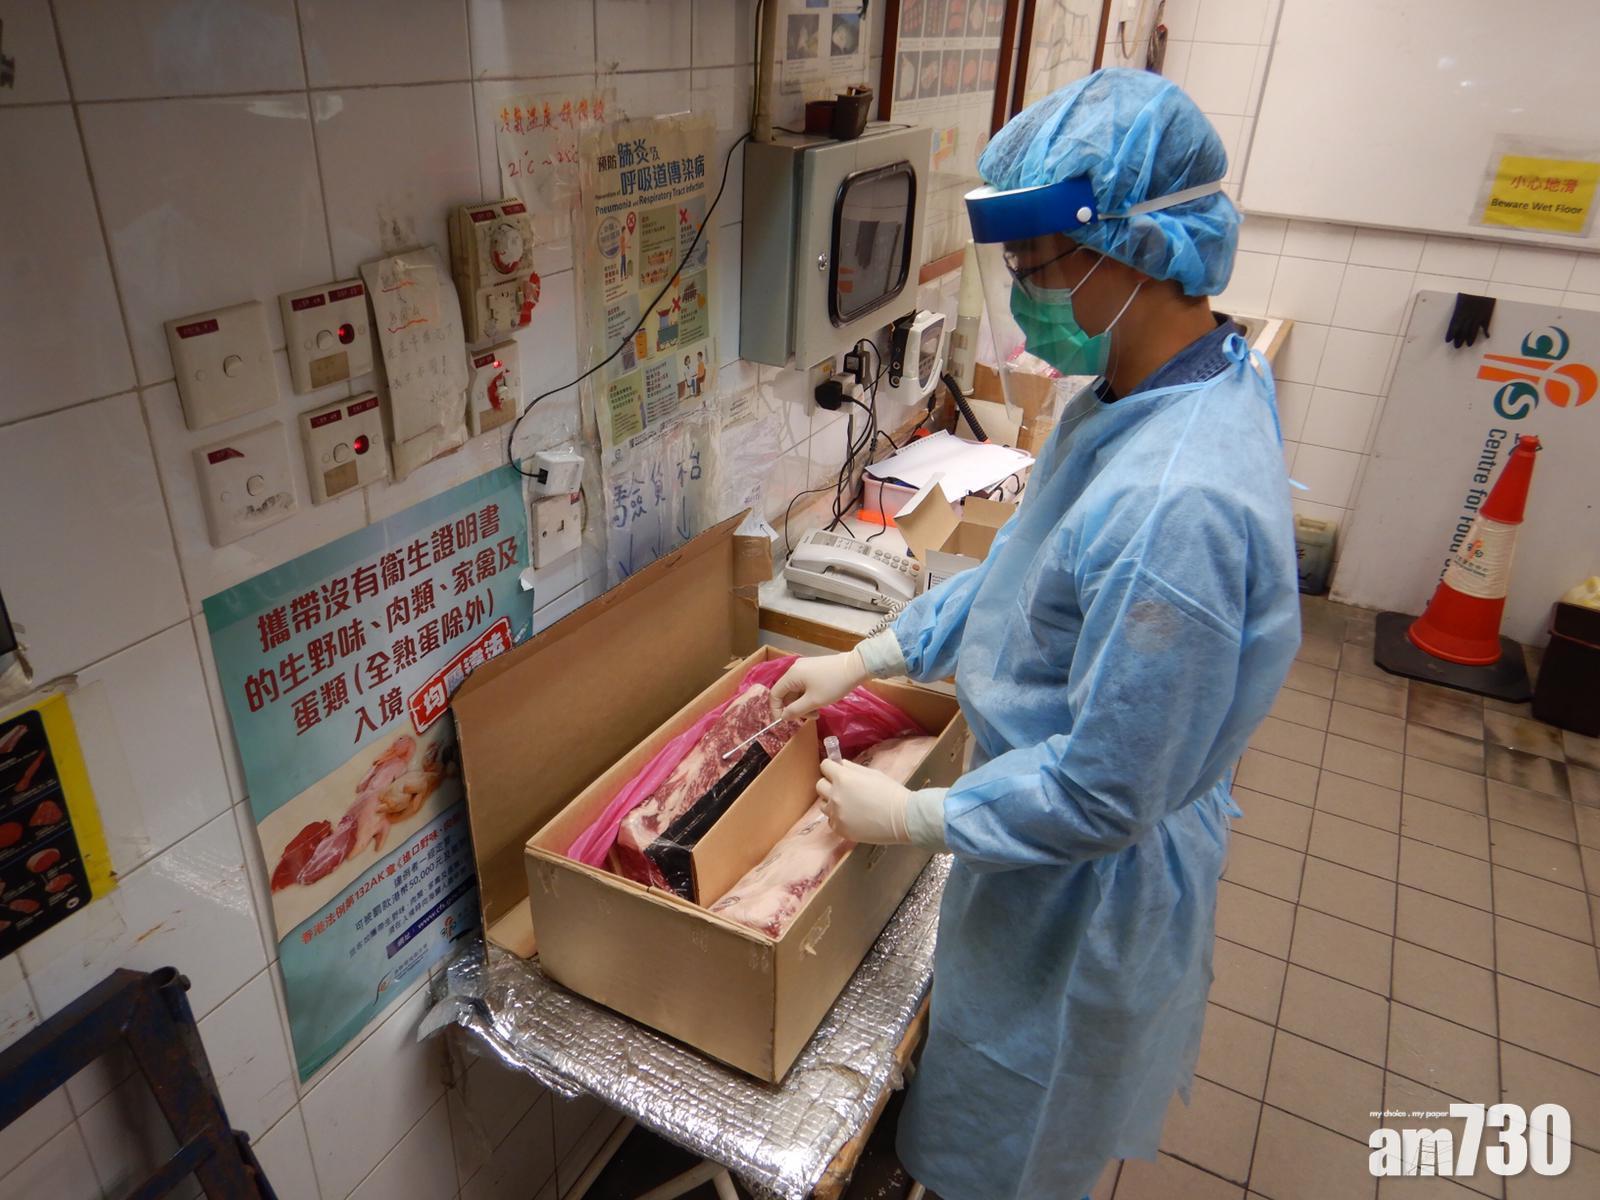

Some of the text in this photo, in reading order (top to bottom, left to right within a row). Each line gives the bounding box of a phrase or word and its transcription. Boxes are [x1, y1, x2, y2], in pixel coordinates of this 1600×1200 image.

[620, 154, 705, 196] 呼吸道傳染病
[595, 199, 631, 216] Pneumonia
[639, 190, 672, 205] Respiratory
[1490, 198, 1584, 214] Beware Wet Floor
[1473, 428, 1507, 484] Centre
[1464, 488, 1488, 513] for
[353, 686, 404, 744] 入境
